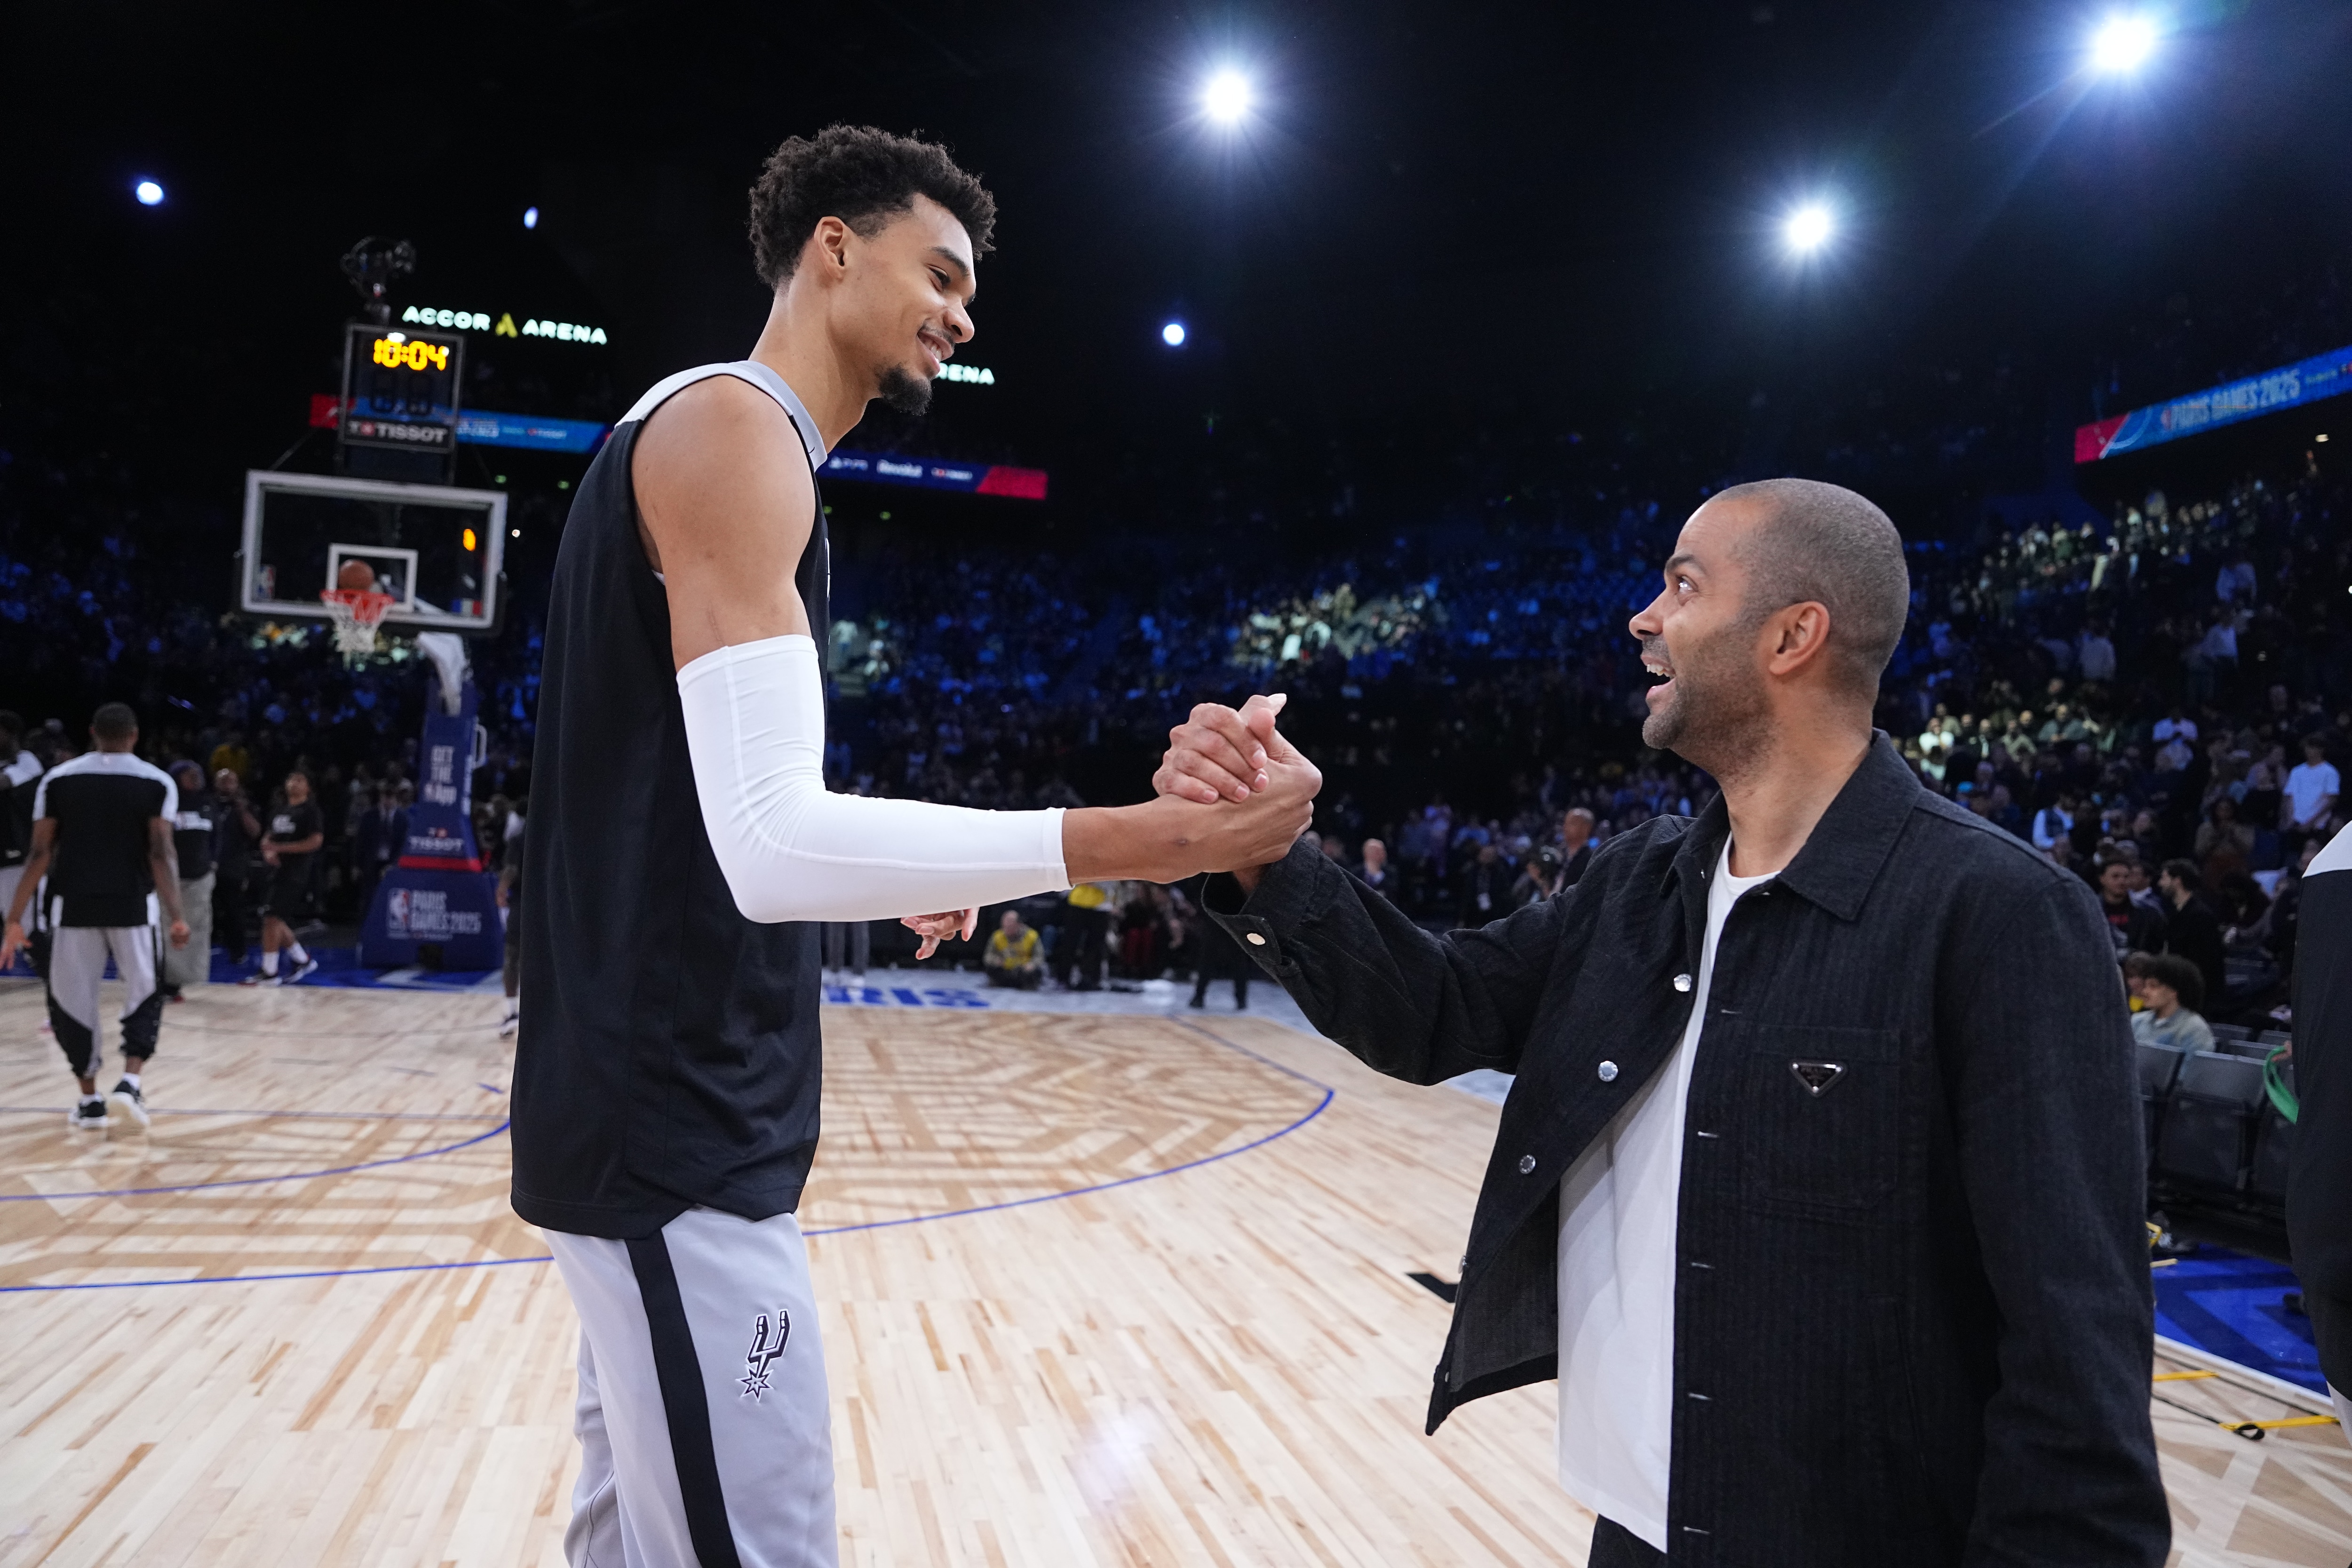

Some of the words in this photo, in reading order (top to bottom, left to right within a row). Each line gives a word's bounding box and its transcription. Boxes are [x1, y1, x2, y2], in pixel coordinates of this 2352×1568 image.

[402, 306, 490, 331] ACCOR
[522, 319, 607, 345] ARENA
[373, 338, 448, 371] 10:04
[376, 422, 447, 443] TISSOT
